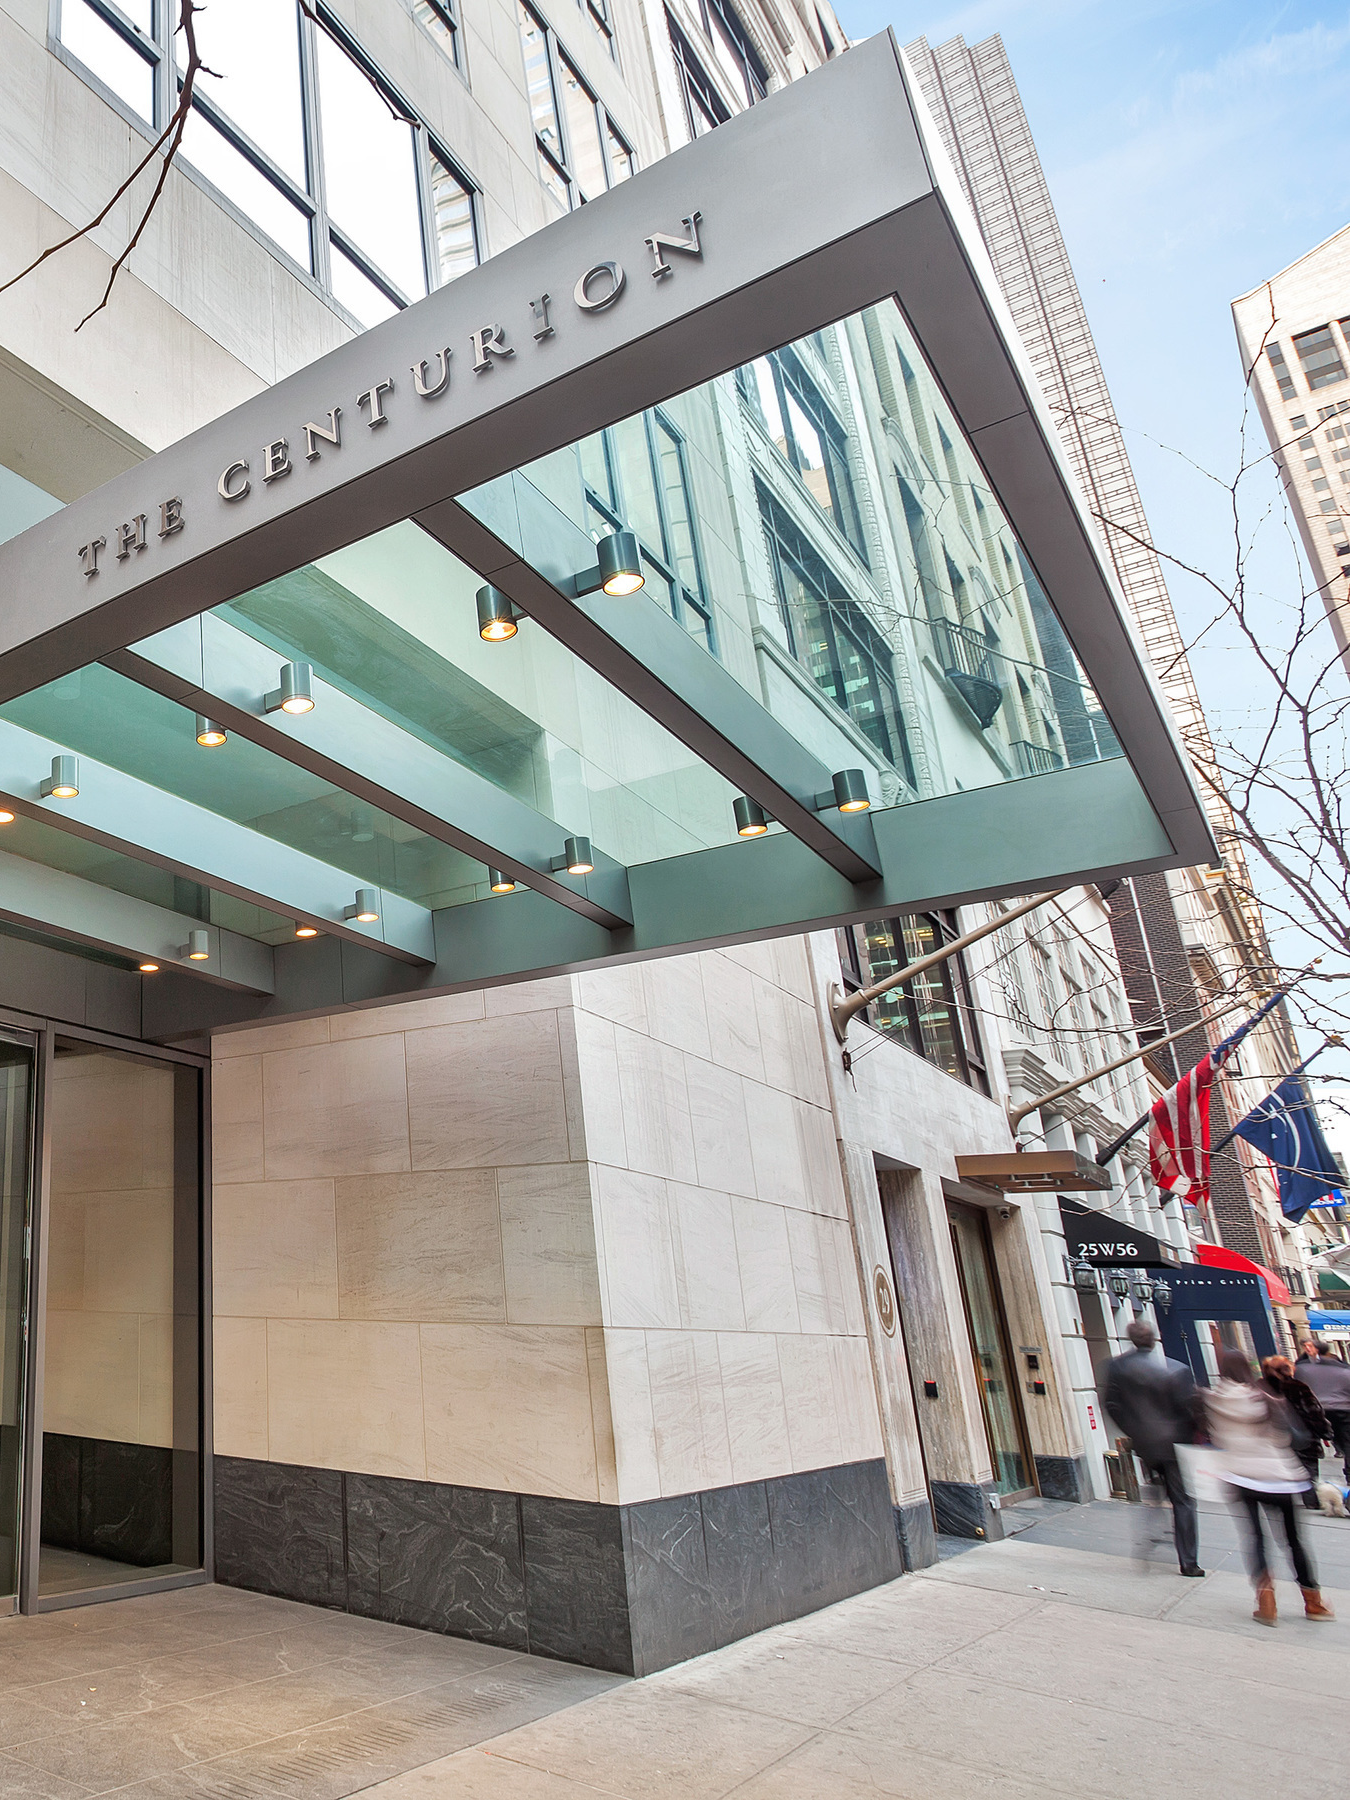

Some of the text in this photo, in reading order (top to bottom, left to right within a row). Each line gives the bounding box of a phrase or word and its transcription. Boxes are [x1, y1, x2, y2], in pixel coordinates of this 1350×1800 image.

[77, 210, 705, 579] THE CENTURION
[1077, 1242, 1139, 1257] 25W56
